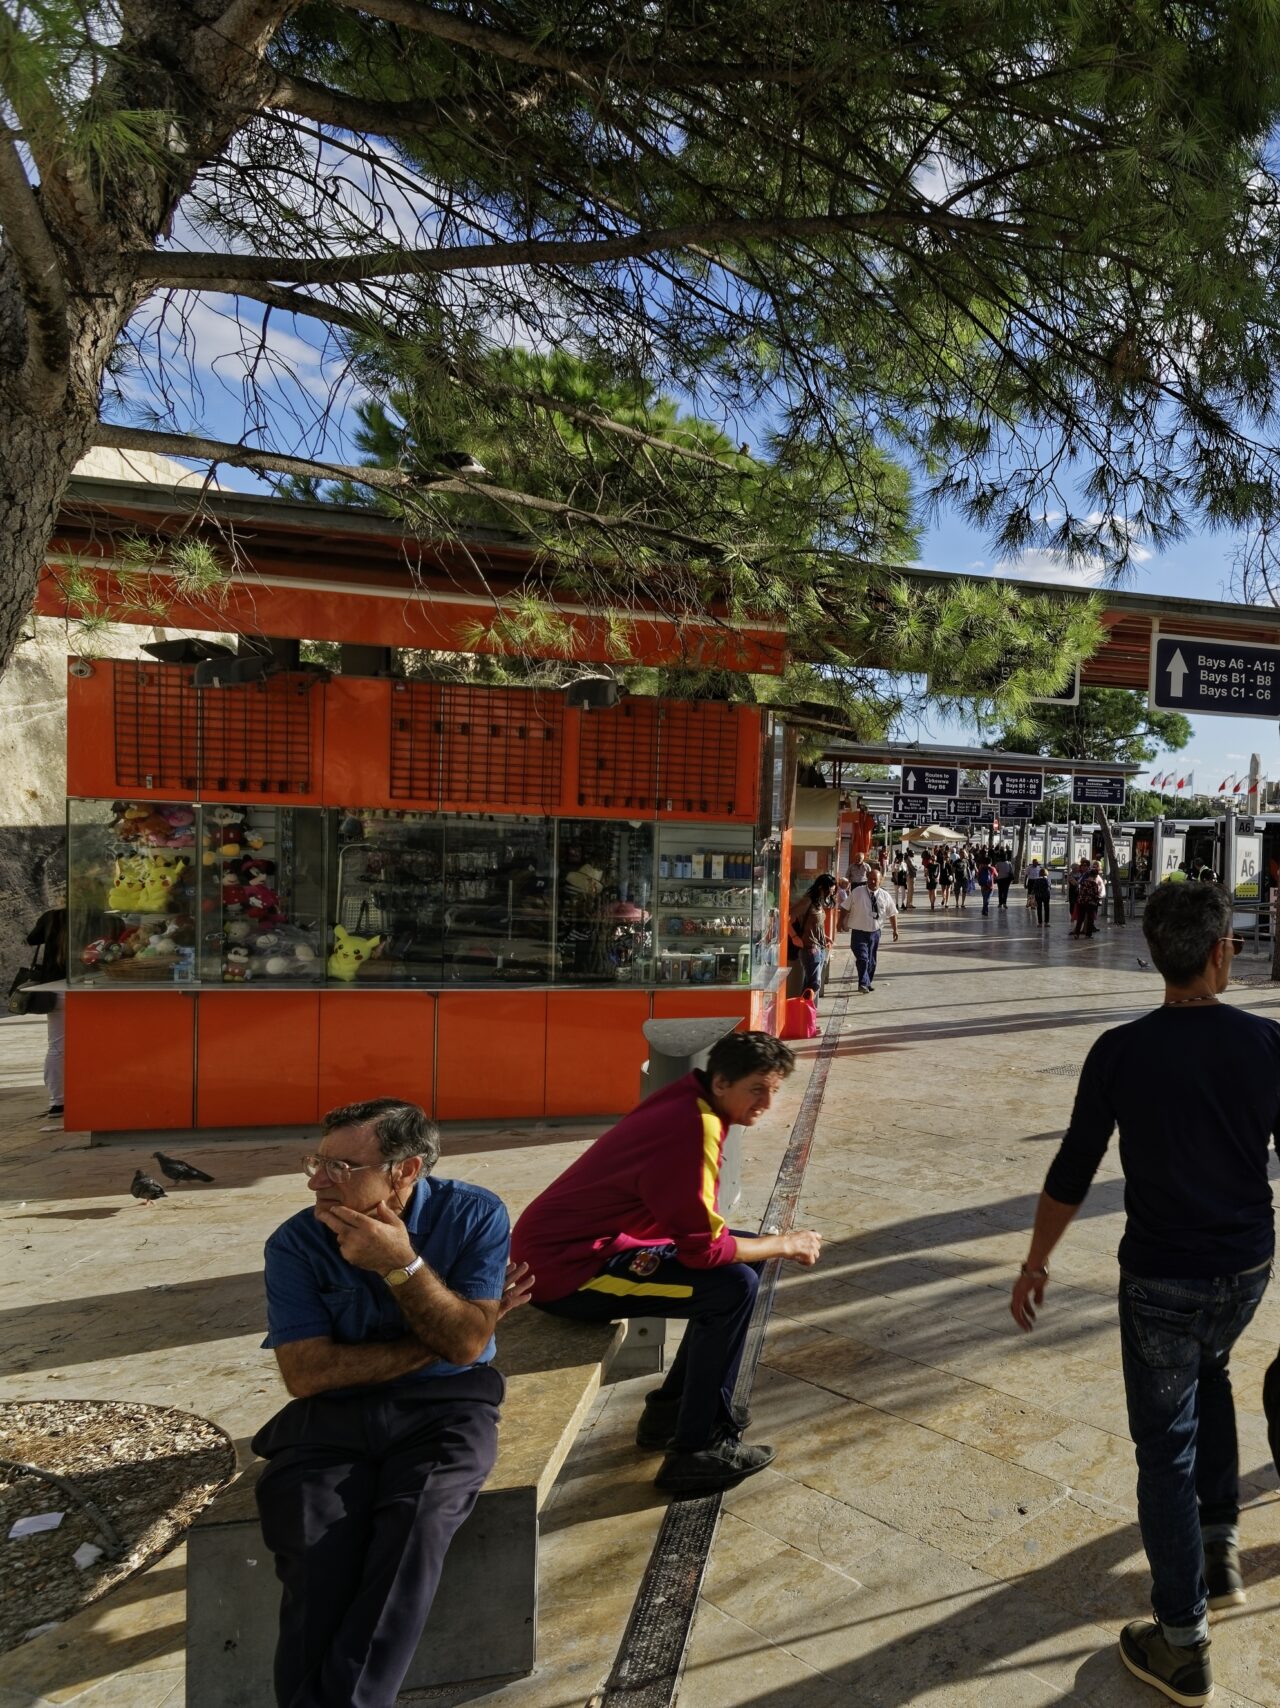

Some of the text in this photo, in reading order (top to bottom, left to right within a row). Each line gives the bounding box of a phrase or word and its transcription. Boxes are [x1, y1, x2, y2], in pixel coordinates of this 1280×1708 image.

[1198, 656, 1226, 669] Bays
[1229, 659, 1244, 669] A6
[1254, 661, 1275, 672] A15
[1200, 670, 1228, 684] Bays
[1232, 673, 1245, 683] B1
[1257, 675, 1271, 686] B8
[1200, 685, 1227, 698] Bays
[1231, 687, 1244, 698] C1
[1256, 690, 1270, 699] C6
[1164, 827, 1172, 835] A7
[1239, 822, 1250, 832] A6
[1052, 847, 1063, 855] A10
[1078, 849, 1086, 860] A9
[1167, 855, 1178, 869] A7
[1241, 859, 1254, 877] A6
